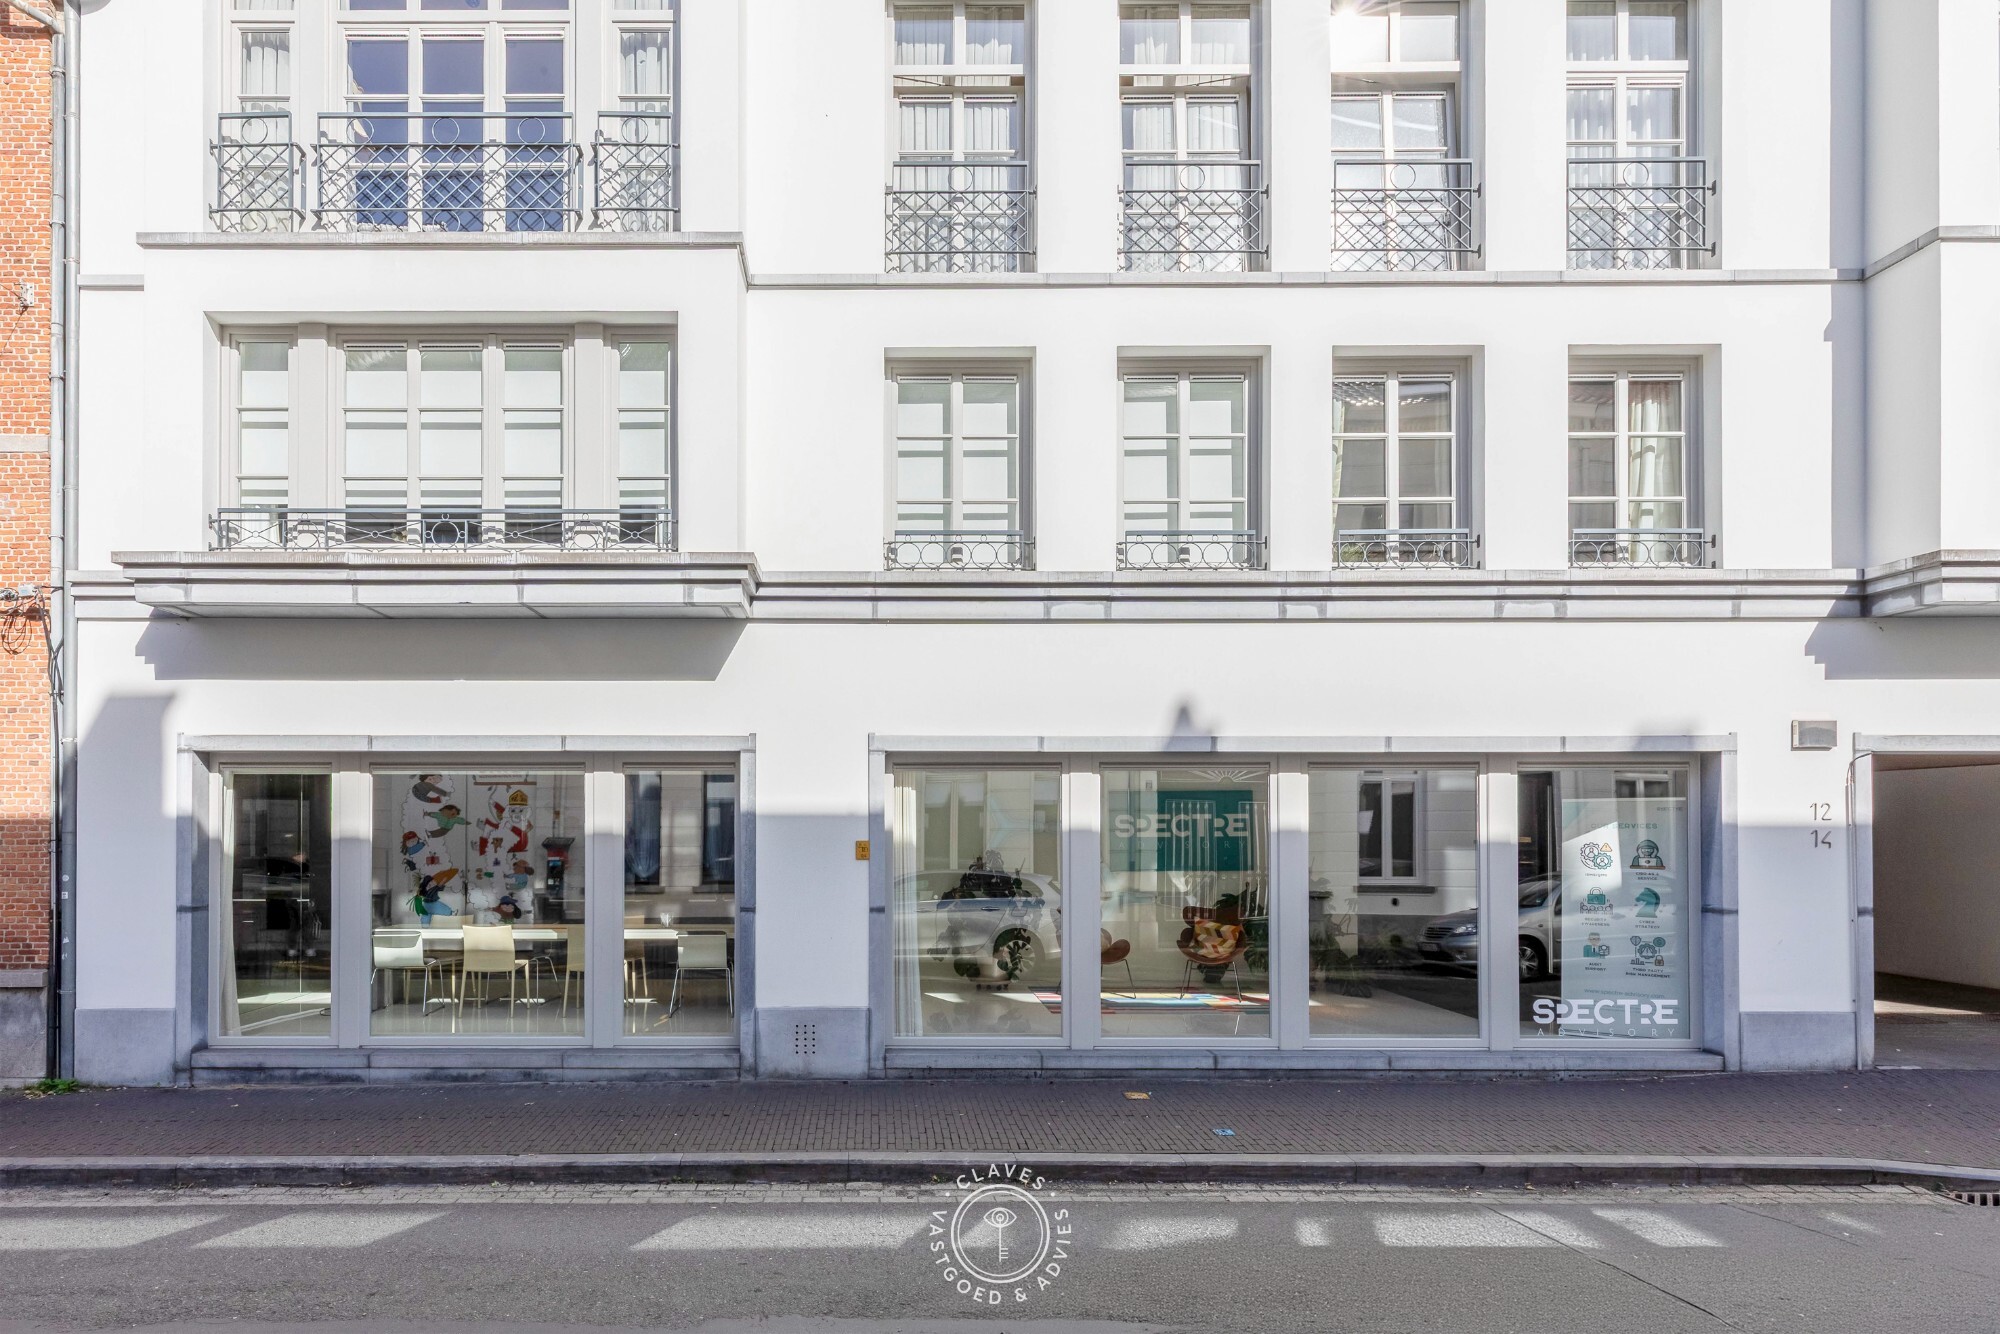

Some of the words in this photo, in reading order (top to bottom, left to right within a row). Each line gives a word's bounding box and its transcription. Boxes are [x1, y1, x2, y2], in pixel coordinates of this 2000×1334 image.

[1809, 802, 1833, 822] 12
[1114, 813, 1249, 838] SPECTRE
[1612, 822, 1658, 830] SERVICES
[1118, 840, 1246, 849] ADVSORY
[1810, 829, 1832, 849] 14
[1532, 998, 1679, 1025] SPECTRE
[1537, 1028, 1675, 1037] ADVISORY
